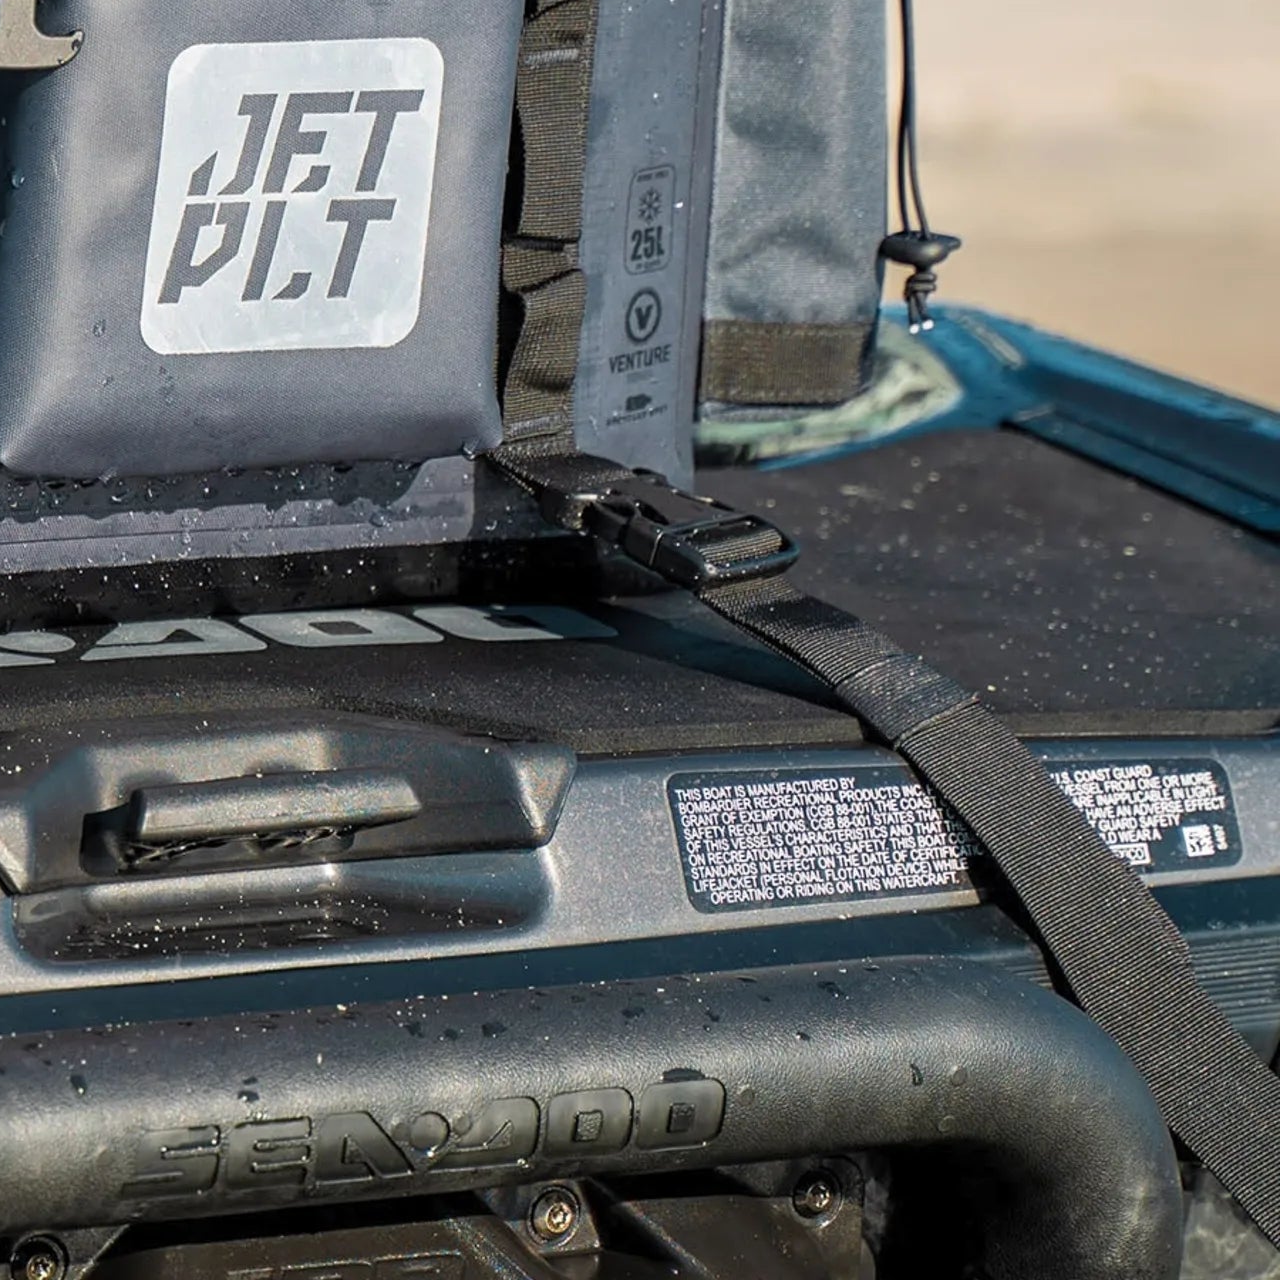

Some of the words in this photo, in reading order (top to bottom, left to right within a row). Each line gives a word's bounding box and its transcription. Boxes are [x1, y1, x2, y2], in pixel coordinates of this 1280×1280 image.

[186, 89, 425, 196] JET
[630, 226, 665, 261] 25L
[609, 344, 671, 373] VENTURE
[675, 788, 702, 801] THIS
[703, 786, 732, 800] BOAT
[734, 785, 745, 797] IS
[748, 778, 838, 796] MANUFACTURED
[839, 777, 855, 789] BY
[679, 798, 751, 814] BOMBARDIER
[754, 792, 838, 808] RECREATIONAL
[839, 786, 901, 802] PRODUCTS
[901, 784, 926, 796] INC.
[1074, 769, 1111, 783] COAST
[1113, 765, 1152, 778] GUARD
[681, 813, 719, 827] GRANT
[722, 812, 737, 824] OF
[739, 808, 803, 822] EXEMPTION
[806, 804, 834, 820] (CGB
[876, 800, 898, 813] THE
[900, 796, 937, 810] COAST
[1104, 779, 1136, 792] FROM
[1138, 777, 1161, 790] ONE
[1162, 775, 1179, 787] OR
[1180, 772, 1213, 786] MORE
[684, 826, 725, 840] SAFETY
[810, 818, 835, 830] CGB
[837, 815, 871, 827] 88-001
[873, 811, 915, 826] STATES
[916, 808, 943, 822] THAT
[1096, 789, 1171, 806] INAPPLICABLE
[1172, 789, 1185, 800] IN
[1185, 785, 1217, 798] LIGHT
[686, 841, 701, 853] OF
[703, 838, 729, 852] THIS
[785, 826, 888, 845] CHARACTERISTICS
[889, 824, 913, 837] AND
[915, 822, 942, 834] THAT
[1085, 806, 1116, 819] HAVE
[1116, 805, 1132, 816] AN
[1133, 801, 1184, 815] ADVERSE
[1185, 797, 1225, 812] EFFECT
[689, 854, 706, 866] ON
[708, 846, 792, 865] RECREATIONAL
[794, 842, 842, 857] BOATING
[889, 837, 916, 850] THIS
[917, 834, 947, 847] BOAT
[1098, 817, 1137, 831] GUARD
[1139, 815, 1181, 827] SAFETY
[691, 862, 757, 879] STANDARDS
[760, 862, 771, 873] IN
[773, 858, 815, 872] EFFECT
[818, 856, 835, 867] ON
[837, 855, 860, 867] THE
[862, 852, 890, 865] DATE
[892, 850, 908, 862] OF
[1118, 829, 1152, 842] WEAR
[1153, 828, 1162, 840] A
[693, 877, 757, 892] LIFEJACKET
[761, 871, 824, 889] (PERSONAL
[825, 864, 885, 880] FLOTATION
[887, 861, 932, 875] DEVICE)
[933, 858, 968, 871] WHILE
[711, 888, 774, 903] OPERATING
[776, 886, 794, 899] OR
[796, 883, 834, 897] RIDING
[836, 882, 853, 893] ON
[855, 878, 880, 891] THIS
[882, 872, 960, 889] WATERCRAFT.
